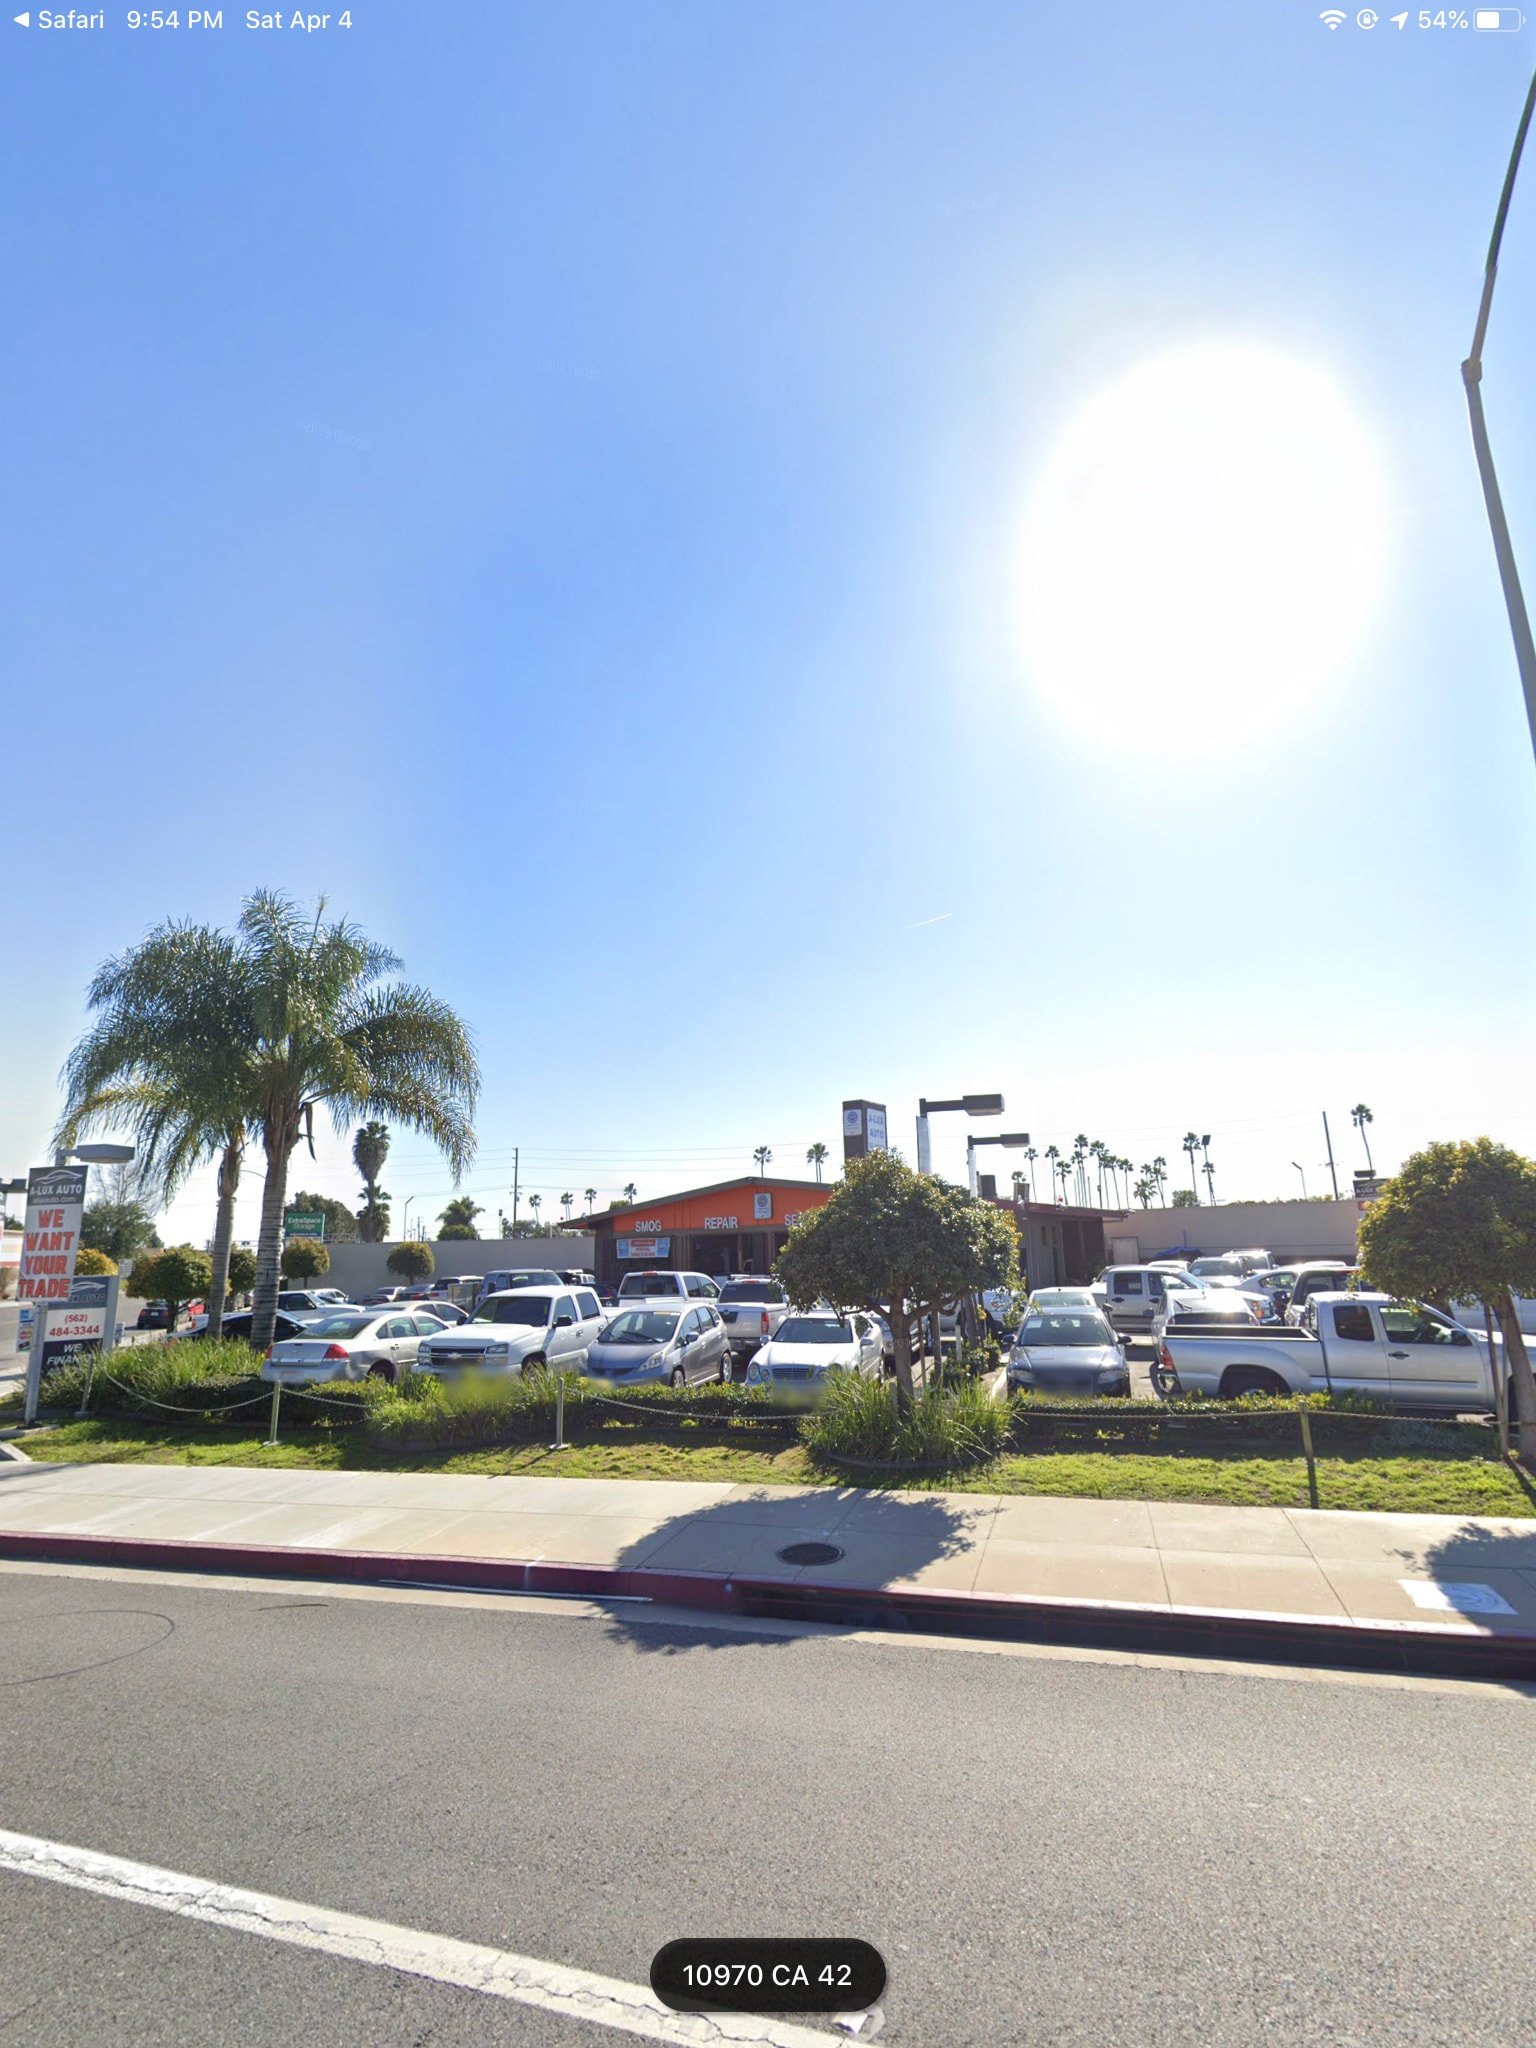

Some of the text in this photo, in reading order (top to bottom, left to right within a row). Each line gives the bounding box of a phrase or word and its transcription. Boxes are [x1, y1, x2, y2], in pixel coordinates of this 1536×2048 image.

[56, 1184, 83, 1195] AUTO
[38, 1209, 65, 1228] WE
[704, 1216, 739, 1230] REPAIR
[635, 1220, 662, 1233] SMOG
[25, 1232, 75, 1252] WANT
[25, 1255, 68, 1276] YOUR
[18, 1278, 71, 1299] TRADE
[64, 1313, 88, 1325] (562)
[49, 1325, 100, 1337] 484-3344
[64, 1343, 82, 1353] WE
